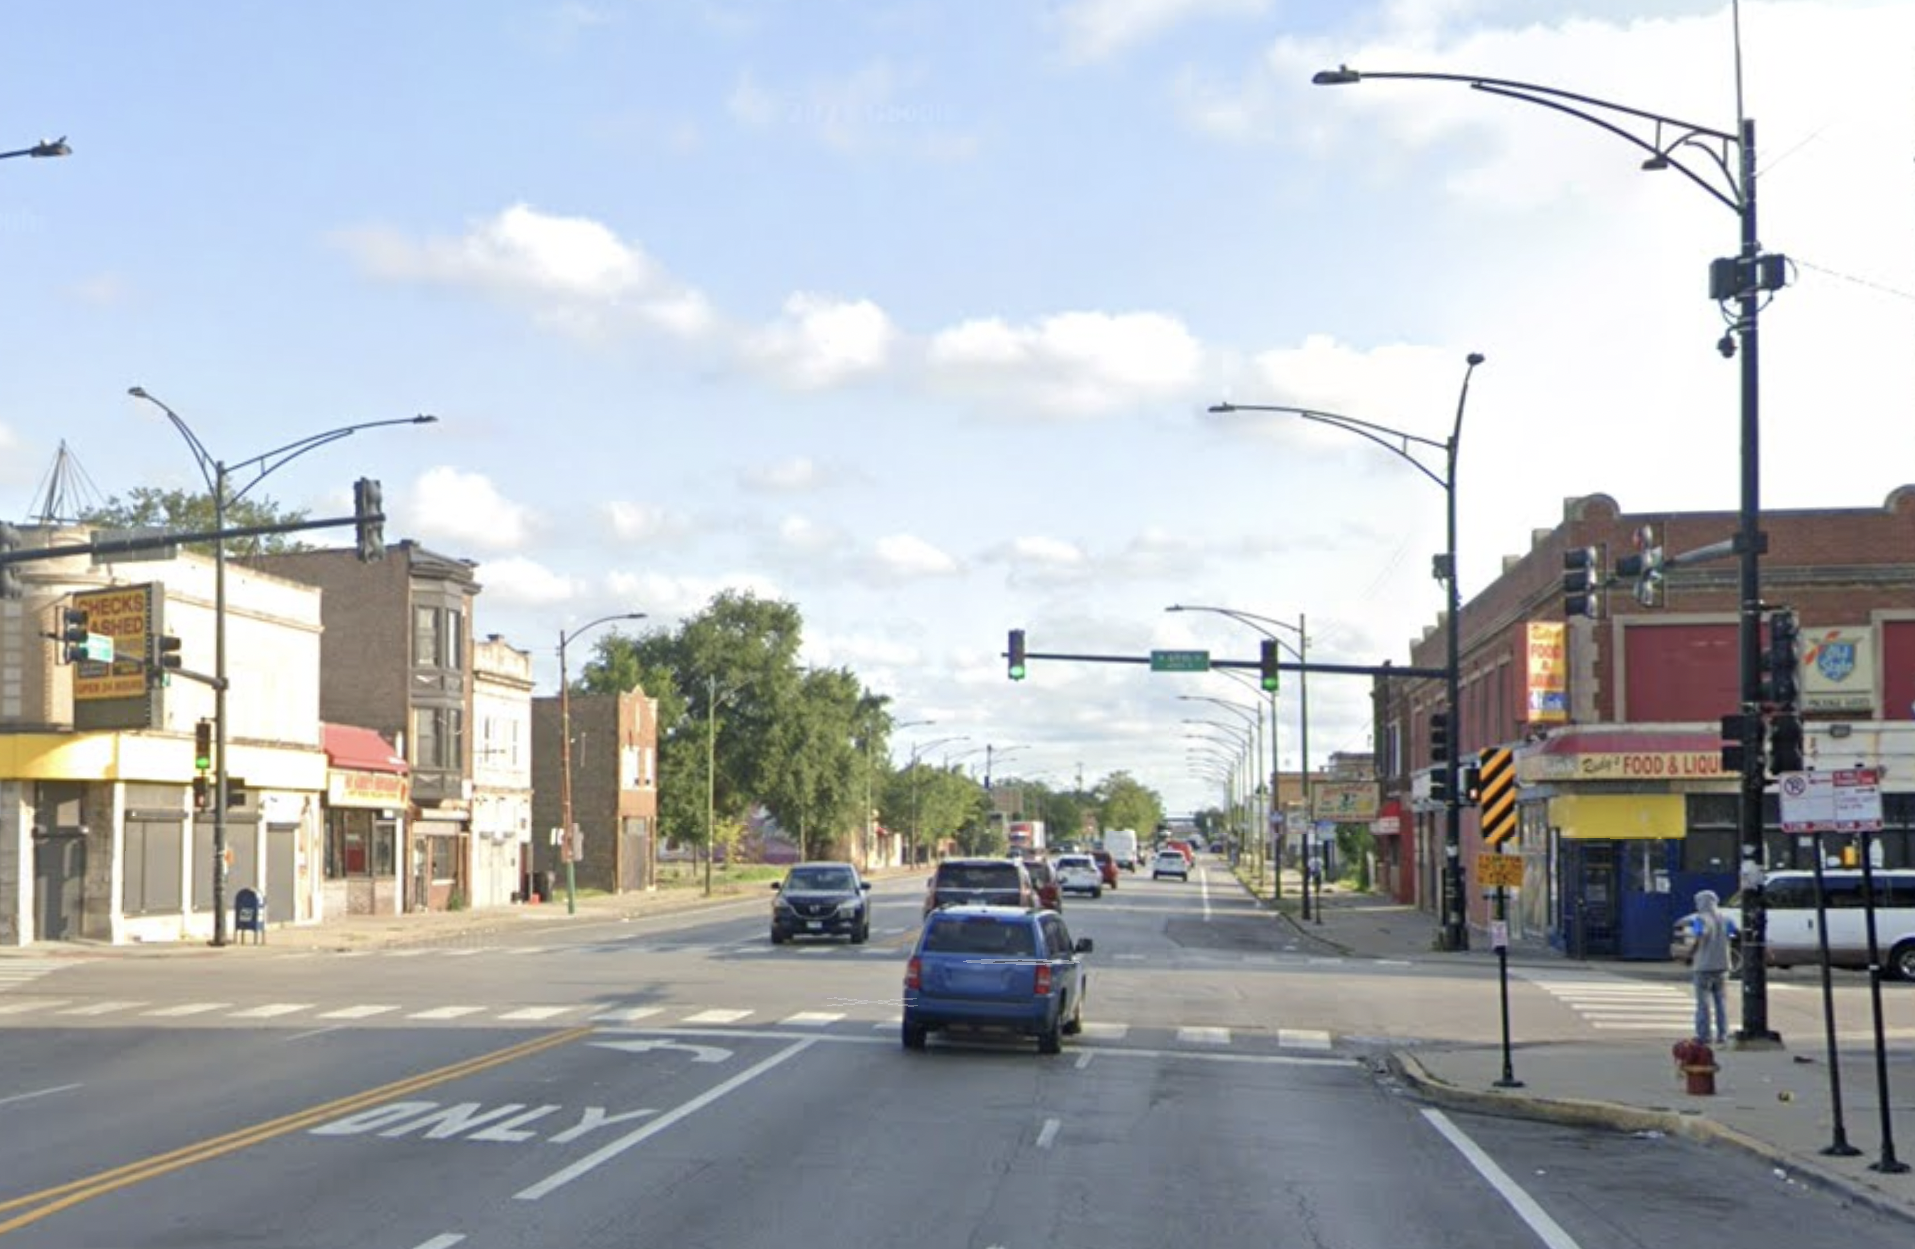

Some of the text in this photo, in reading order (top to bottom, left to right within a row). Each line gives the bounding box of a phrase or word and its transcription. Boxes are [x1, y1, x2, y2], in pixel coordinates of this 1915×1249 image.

[79, 592, 144, 617] CHECKS
[87, 616, 144, 637] ASHED
[1624, 755, 1664, 774] FOOD
[1667, 755, 1679, 774] &
[1683, 755, 1720, 774] LIQU
[307, 1101, 661, 1143] ONLY
